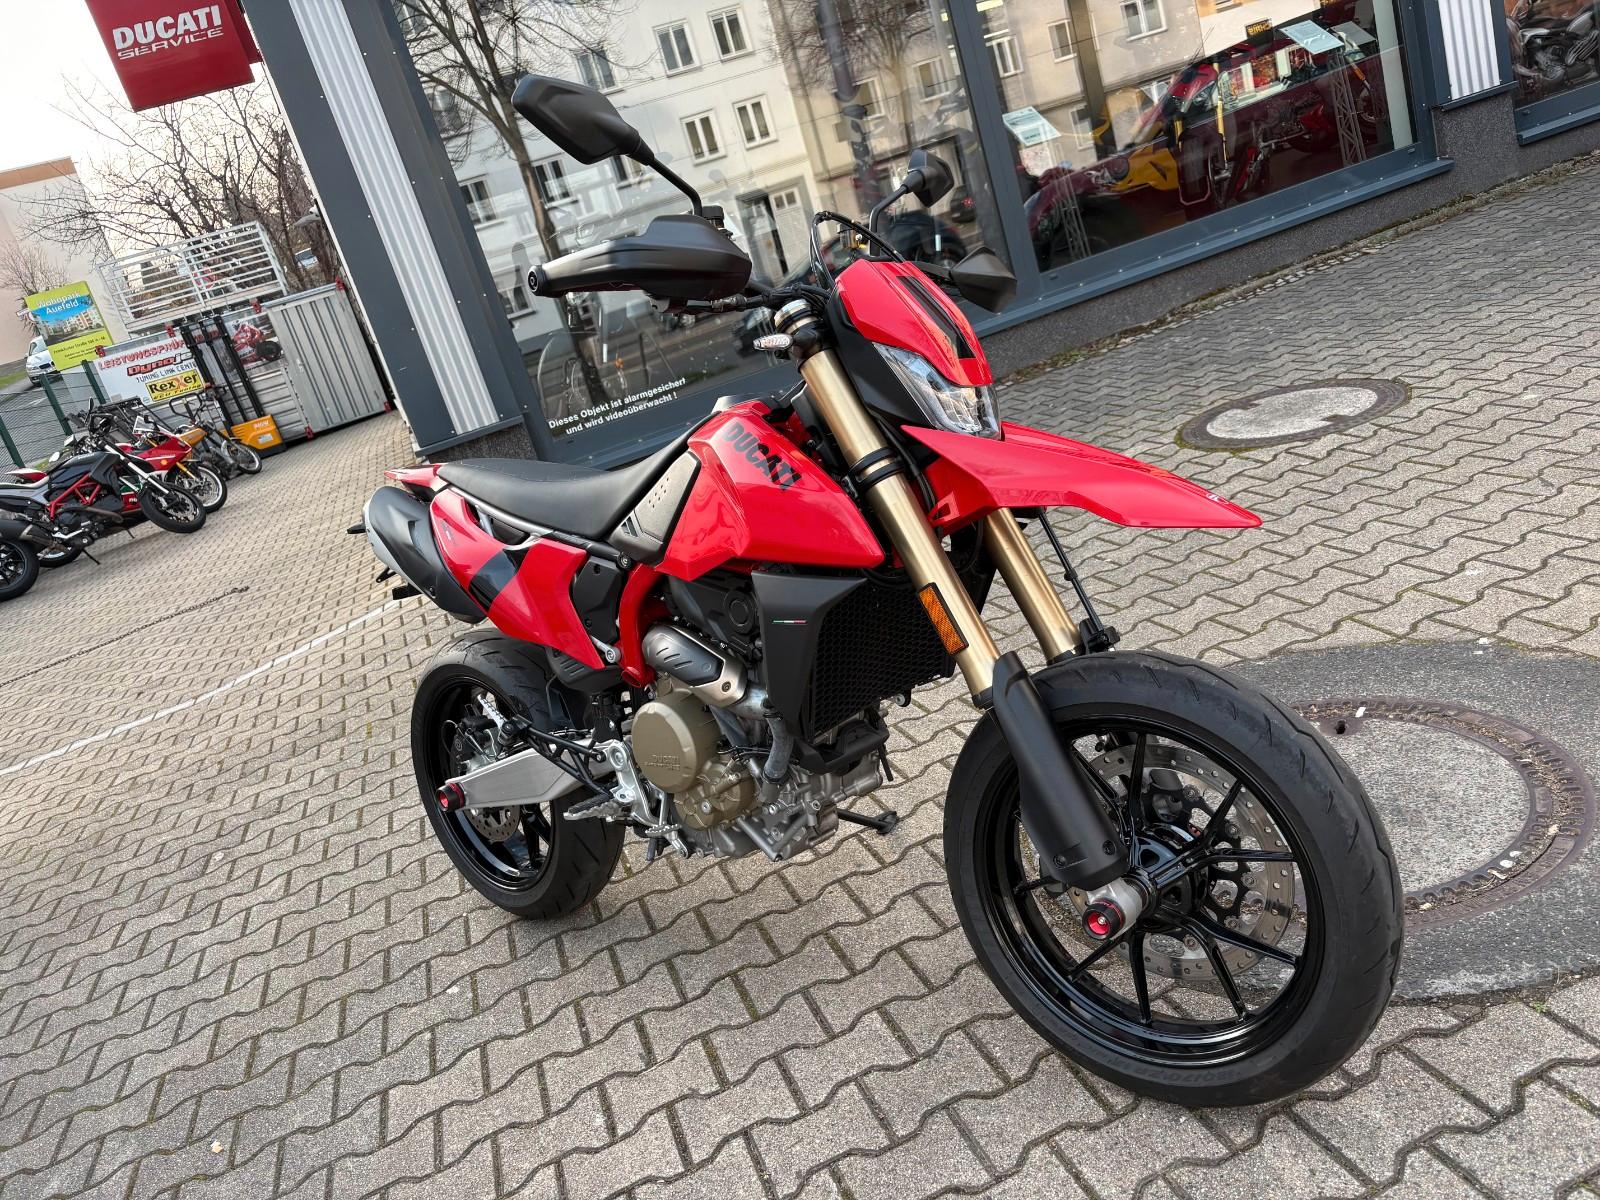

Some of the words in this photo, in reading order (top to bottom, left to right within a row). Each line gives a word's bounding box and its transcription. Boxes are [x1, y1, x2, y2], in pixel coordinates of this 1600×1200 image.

[112, 4, 222, 50] DUCATI
[117, 26, 224, 60] SERVICE
[46, 299, 79, 315] Auefeld
[127, 352, 193, 377] Dynoje
[177, 361, 198, 374] CENTE
[149, 373, 198, 394] RexXer
[548, 414, 579, 429] Dieses
[580, 402, 610, 419] Objekt
[611, 399, 623, 409] ist
[624, 377, 686, 405] alarmgesichert
[566, 422, 583, 435] und
[584, 414, 604, 429] wird
[605, 394, 672, 423] videoüberwacht
[673, 391, 678, 400] !
[722, 421, 802, 491] DUCATI
